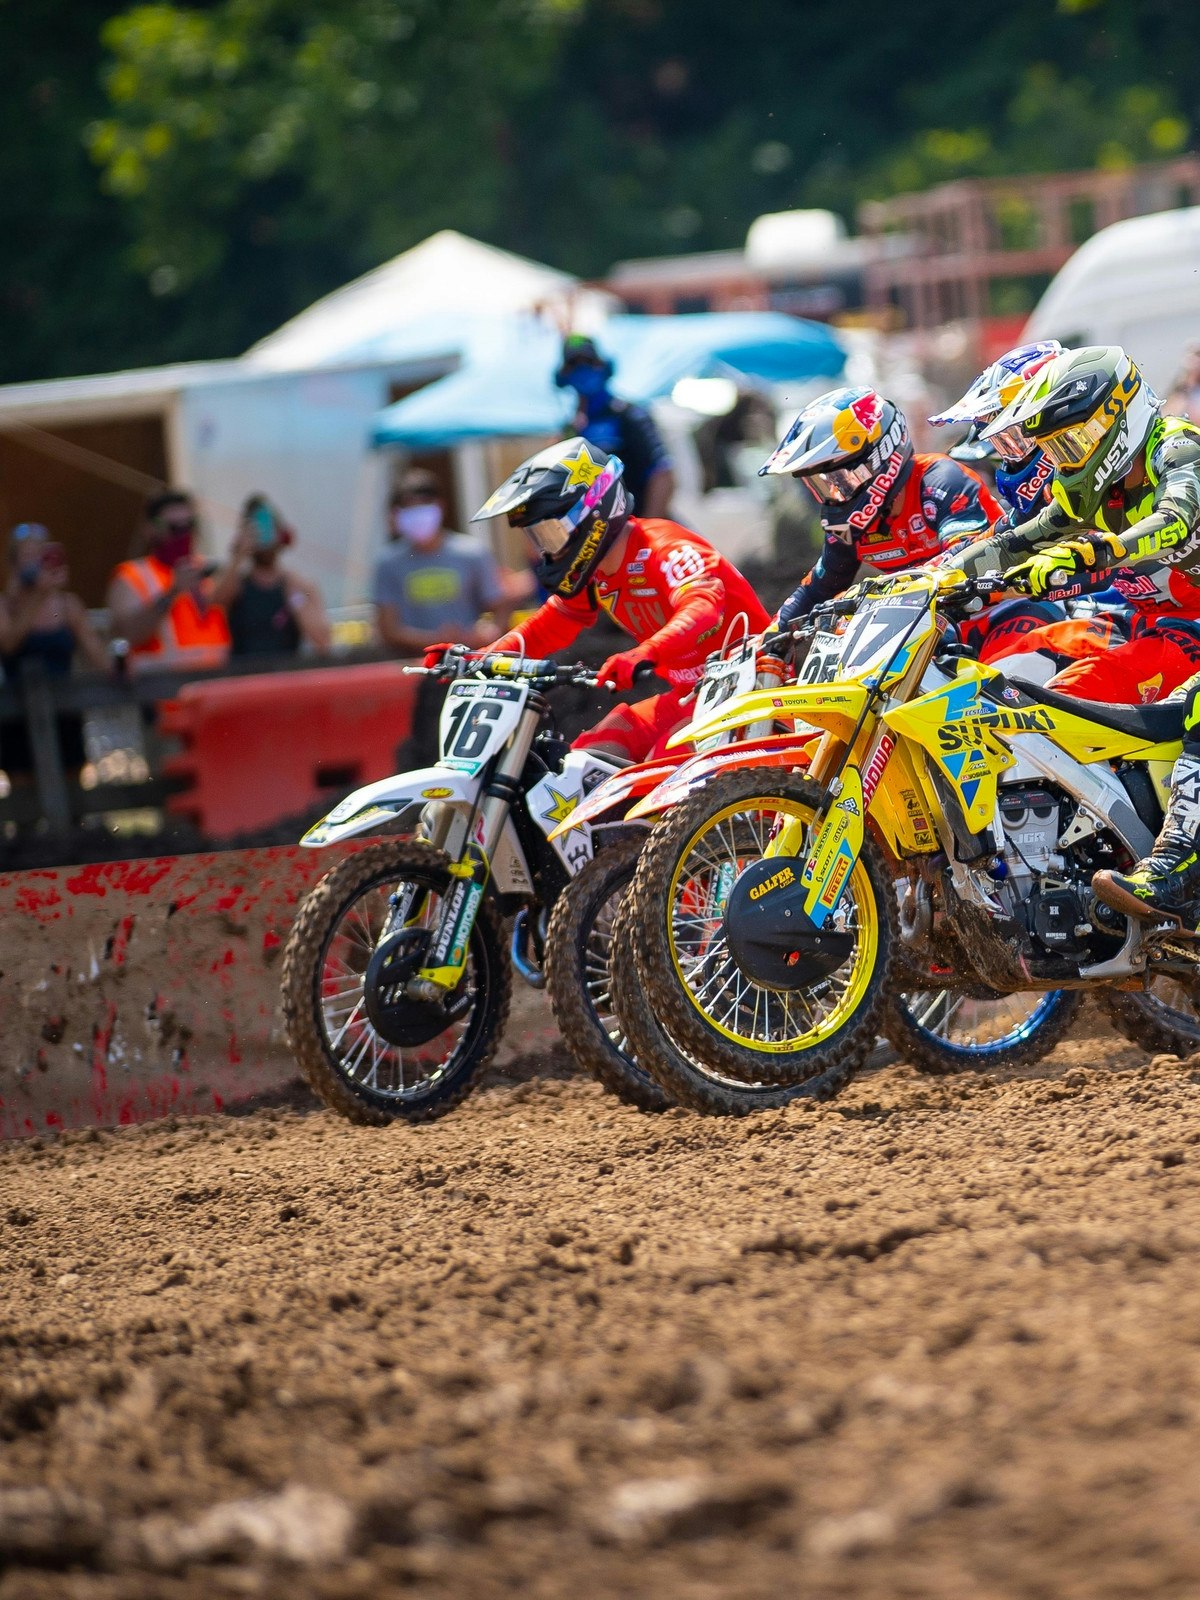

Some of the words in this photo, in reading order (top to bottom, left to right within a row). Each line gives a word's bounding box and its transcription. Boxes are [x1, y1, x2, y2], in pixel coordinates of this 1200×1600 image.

[889, 597, 903, 605] OIL
[838, 607, 924, 669] 17
[485, 686, 499, 697] OIL
[443, 700, 504, 759] 16
[937, 709, 1056, 750] SUZUKI
[804, 859, 816, 881] JE
[813, 822, 833, 860] PISTONS
[1016, 831, 1046, 844] JGR
[750, 867, 794, 900] GALFER
[779, 877, 796, 889] USA
[820, 850, 834, 877] SCOTT
[823, 857, 849, 904] PIRELLI
[435, 881, 466, 962] DUNLOP
[454, 886, 481, 947] MOTOREX
